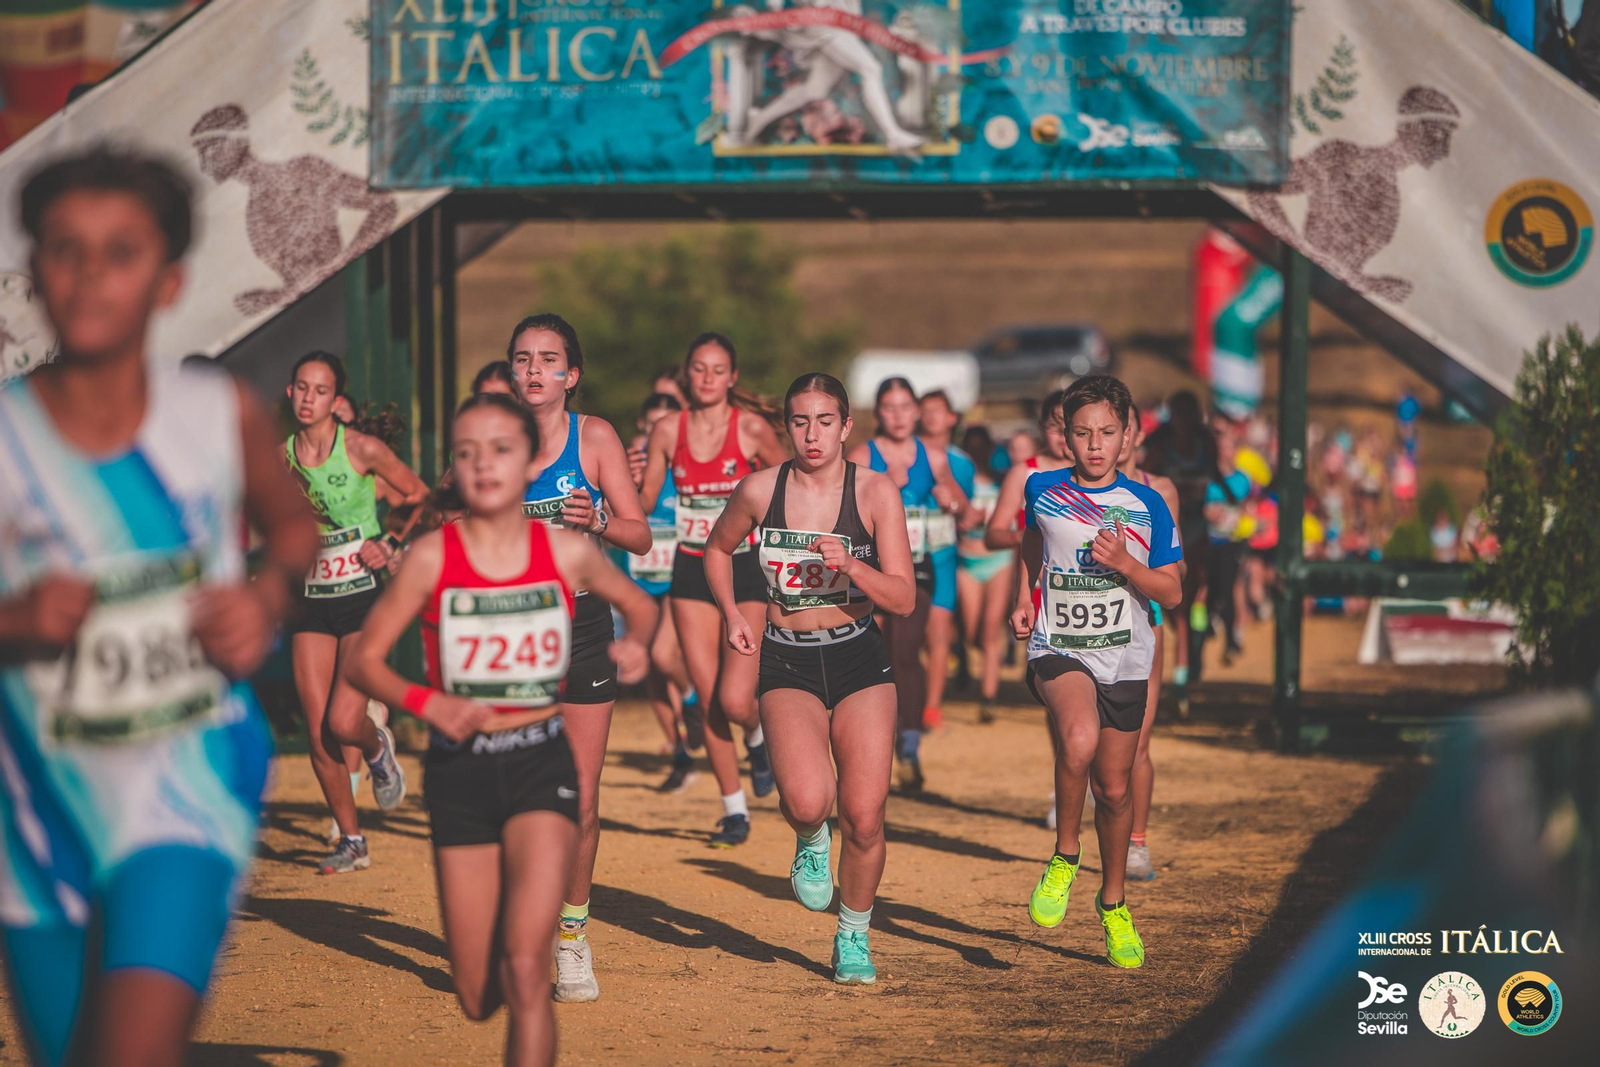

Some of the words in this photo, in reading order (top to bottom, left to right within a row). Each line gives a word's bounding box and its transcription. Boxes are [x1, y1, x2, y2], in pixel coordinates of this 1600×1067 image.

[1127, 16, 1165, 34] POR
[1167, 17, 1247, 36] CLUBES
[1031, 54, 1050, 78] 9
[767, 560, 842, 589] 7287
[1055, 598, 1125, 629] 5937
[457, 629, 561, 671] 7249
